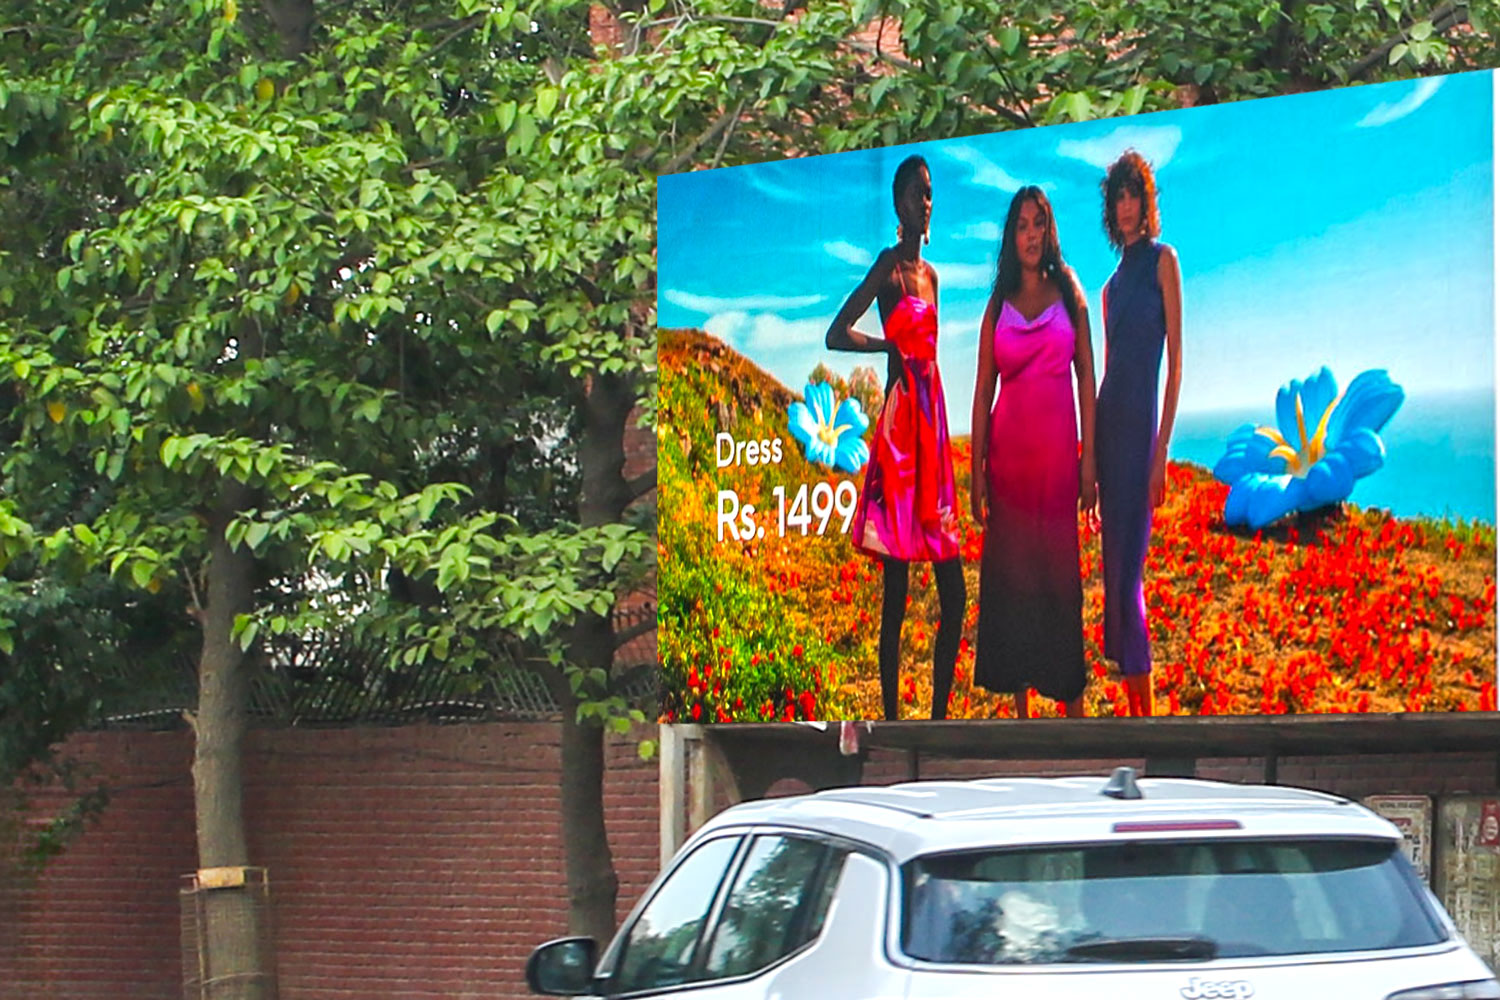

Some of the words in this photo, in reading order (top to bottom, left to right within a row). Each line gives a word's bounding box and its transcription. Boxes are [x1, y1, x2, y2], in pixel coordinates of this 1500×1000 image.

[716, 432, 783, 468] Dress
[717, 489, 765, 542] Rs.
[772, 480, 857, 538] 1499
